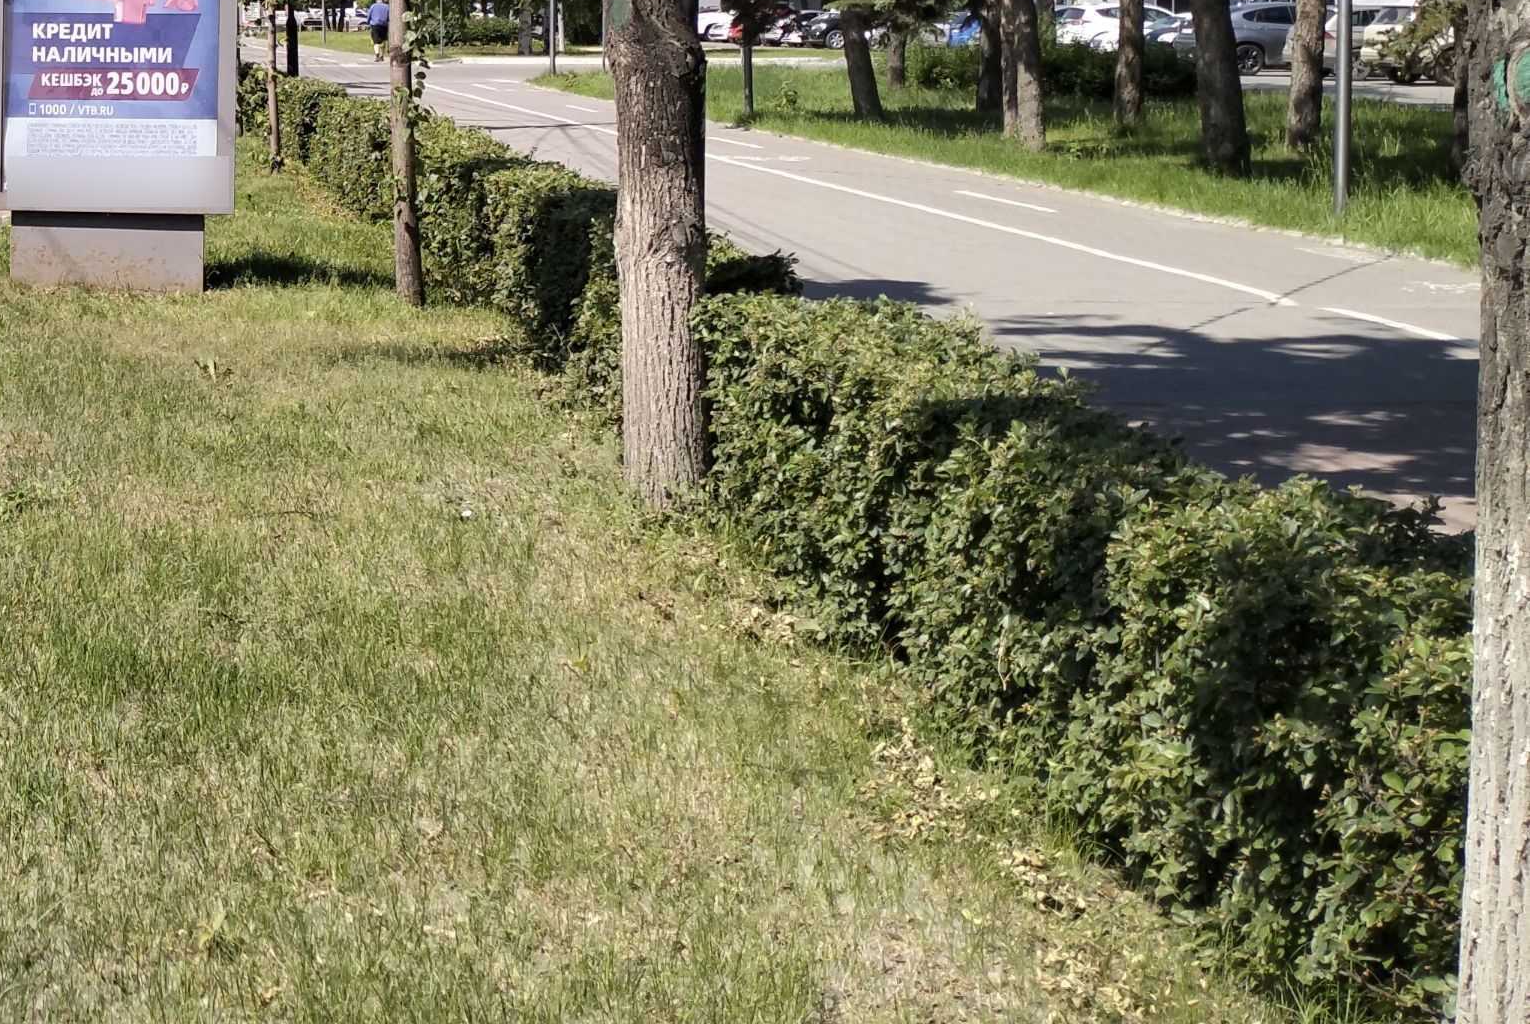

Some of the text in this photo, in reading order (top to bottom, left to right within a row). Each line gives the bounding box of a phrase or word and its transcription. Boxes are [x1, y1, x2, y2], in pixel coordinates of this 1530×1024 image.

[32, 22, 114, 43] КРЕДИТ
[32, 46, 173, 64] НАЛИЧНЫМИ
[41, 72, 103, 87] КЕШБЭК
[39, 103, 67, 116] 1000
[77, 104, 114, 116] VTB.RU
